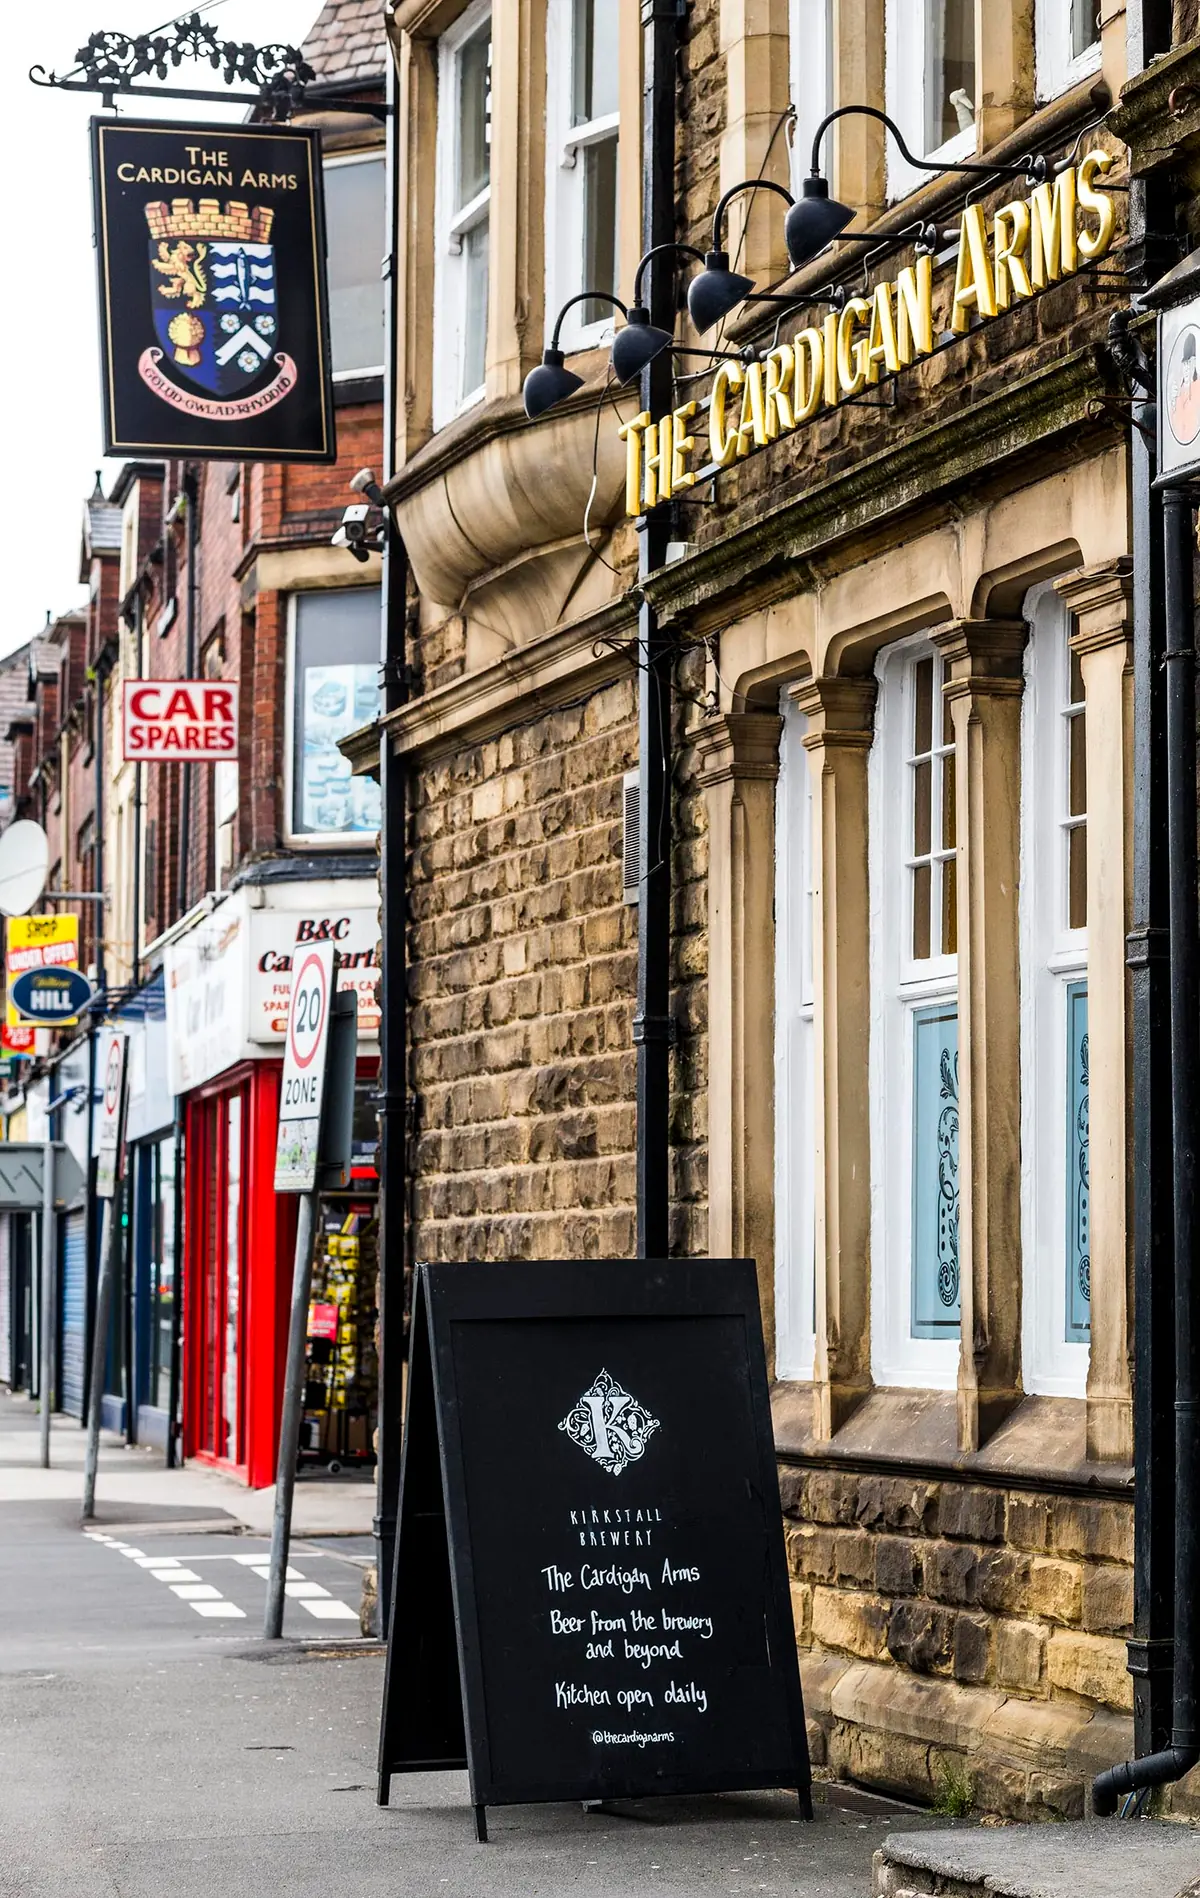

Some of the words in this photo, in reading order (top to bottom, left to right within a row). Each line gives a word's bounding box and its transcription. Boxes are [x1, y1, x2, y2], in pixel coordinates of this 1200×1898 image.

[184, 146, 228, 167] THE
[117, 163, 233, 187] CARDIGAN
[240, 169, 298, 190] ARMS
[618, 400, 697, 517] THE
[709, 254, 933, 468] CARDIGAN
[951, 149, 1117, 335] ARMS
[130, 688, 234, 722] CAR
[129, 725, 235, 750] SPARES
[295, 917, 351, 942] B&C
[258, 950, 293, 973] Ca
[30, 989, 74, 1011] HILL
[296, 987, 321, 1033] 20
[285, 1076, 318, 1105] ZONE
[569, 1508, 662, 1525] KIRKSTALL
[579, 1529, 652, 1546] BREWERY
[541, 1565, 574, 1592] The
[580, 1563, 652, 1594] Cardigan
[661, 1557, 701, 1586] Arms
[550, 1609, 586, 1635] Beer
[590, 1609, 627, 1636] from
[630, 1609, 658, 1632] the
[661, 1608, 714, 1639] brewery
[585, 1639, 615, 1660] and
[624, 1638, 684, 1670] beyond
[555, 1680, 611, 1709] Kitchen
[616, 1689, 654, 1713] open
[664, 1680, 708, 1713] daily
[592, 1730, 675, 1748] @thecardiganarms
